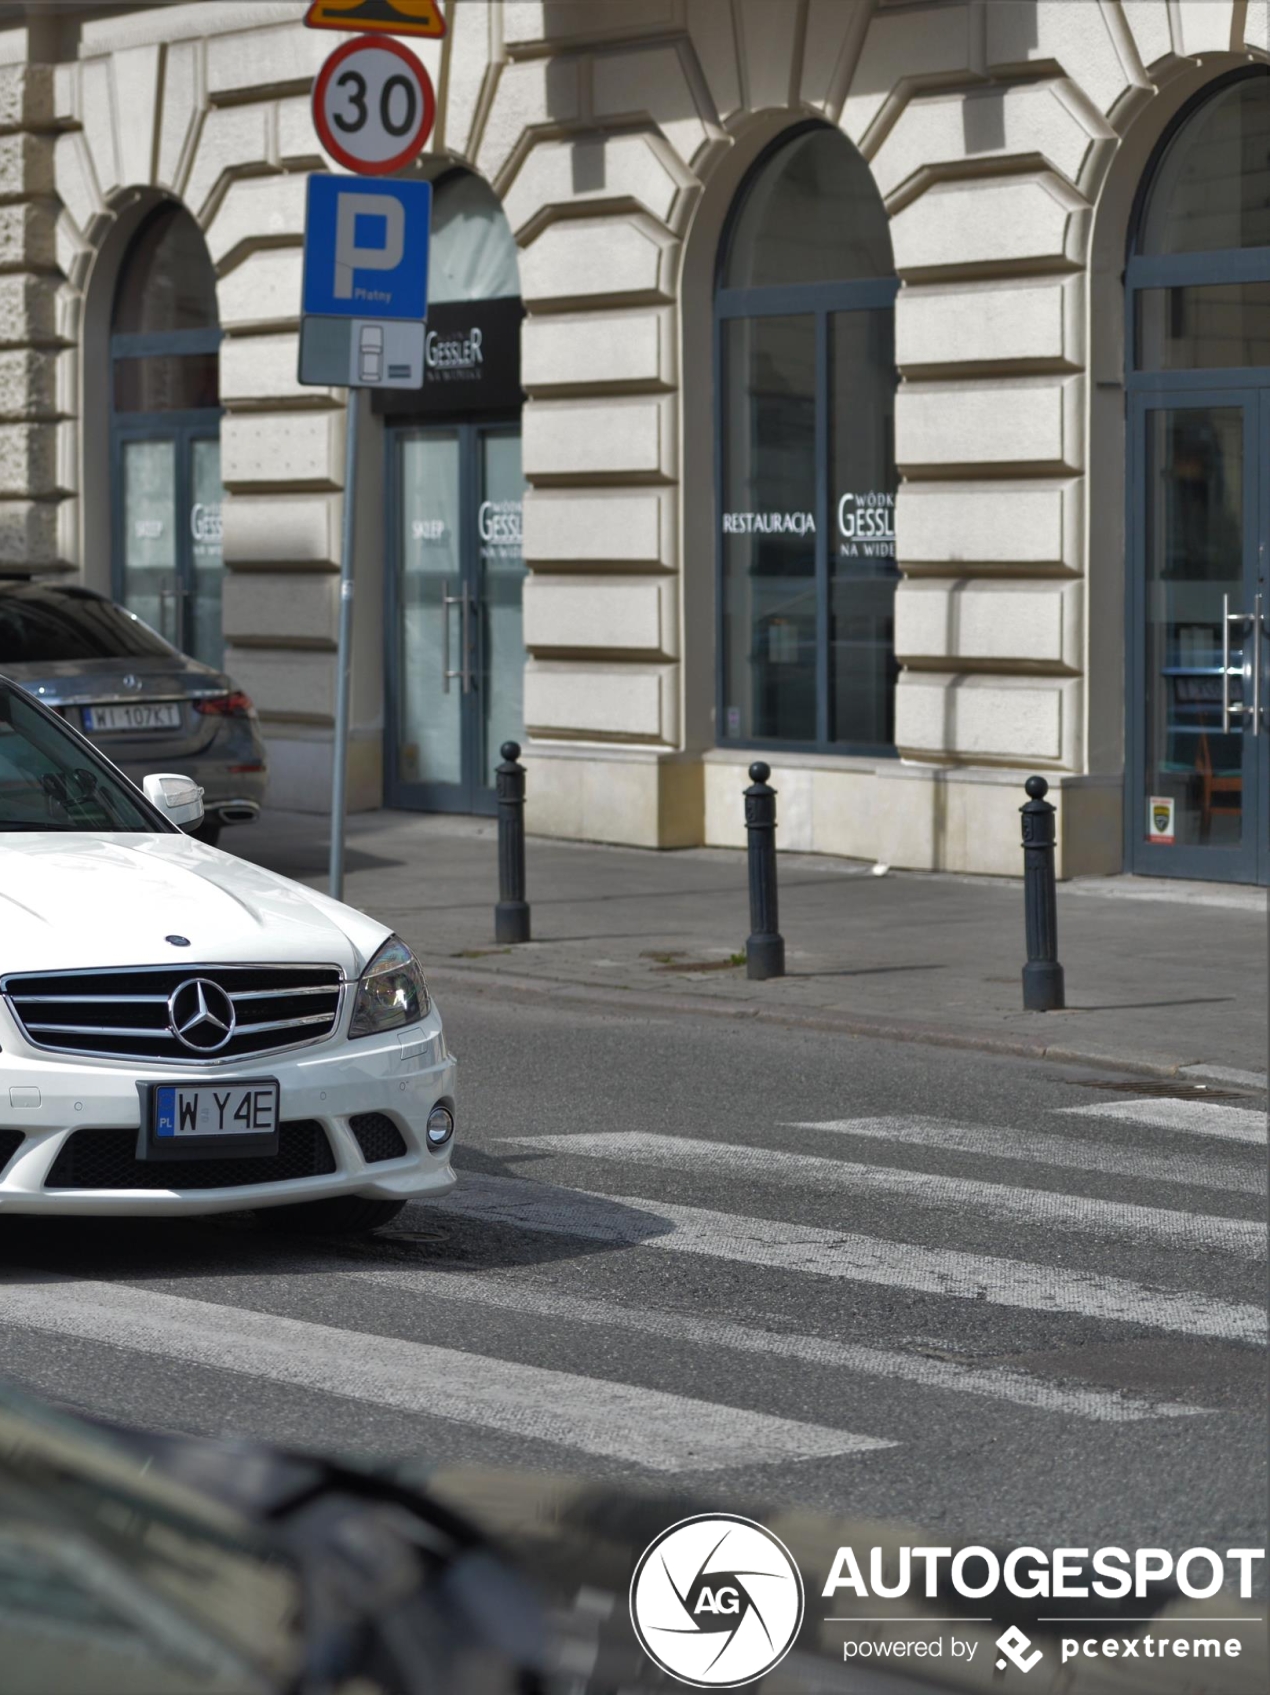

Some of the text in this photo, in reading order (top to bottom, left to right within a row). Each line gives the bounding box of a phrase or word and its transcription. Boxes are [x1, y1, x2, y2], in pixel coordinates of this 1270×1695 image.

[333, 70, 416, 137] 30
[333, 191, 406, 299] P
[723, 512, 816, 538] RESTAURACJA
[841, 543, 858, 557] NA
[159, 1117, 173, 1129] PL
[179, 1091, 273, 1131] W Y4E
